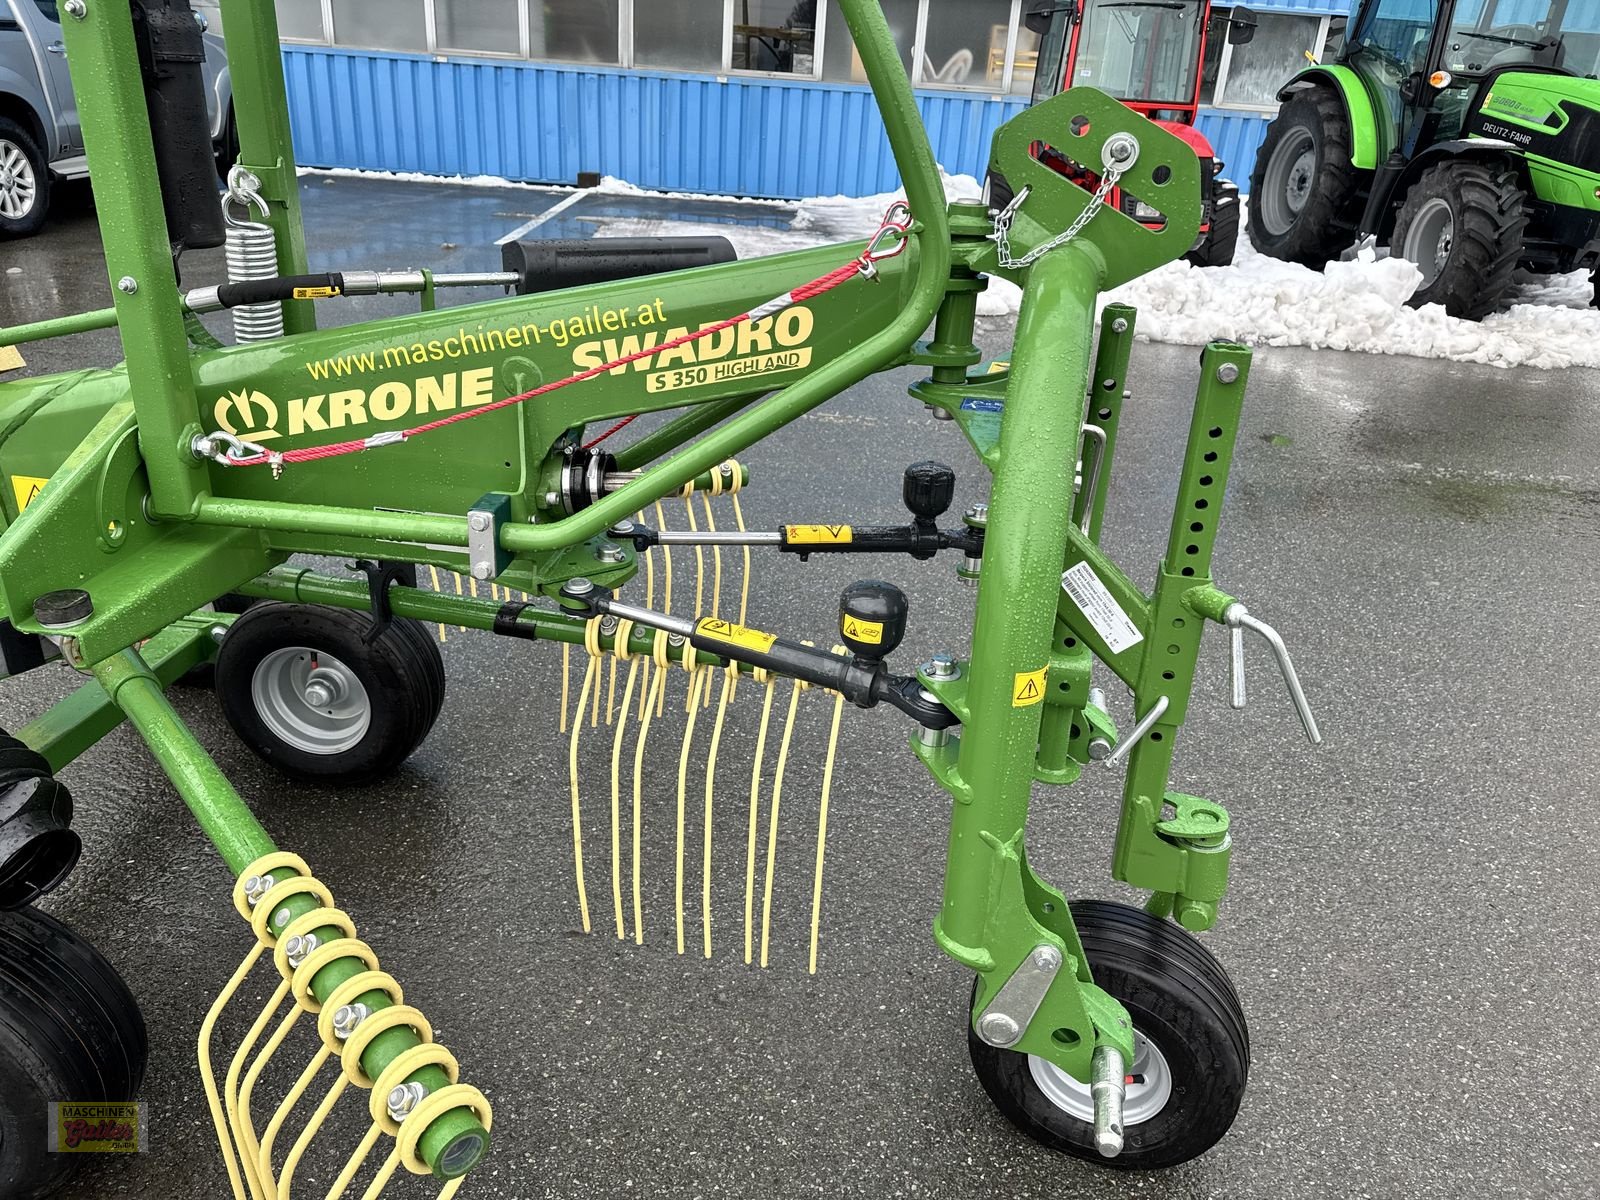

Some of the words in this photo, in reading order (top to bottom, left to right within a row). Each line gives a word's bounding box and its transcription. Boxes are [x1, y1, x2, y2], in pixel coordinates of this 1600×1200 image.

[306, 297, 667, 381] www.maschinen-gailer.at
[572, 305, 814, 381] SWADRO
[655, 374, 667, 391] S
[672, 368, 708, 390] 350
[714, 353, 800, 380] HIGHLAND
[287, 366, 494, 436] KRONE
